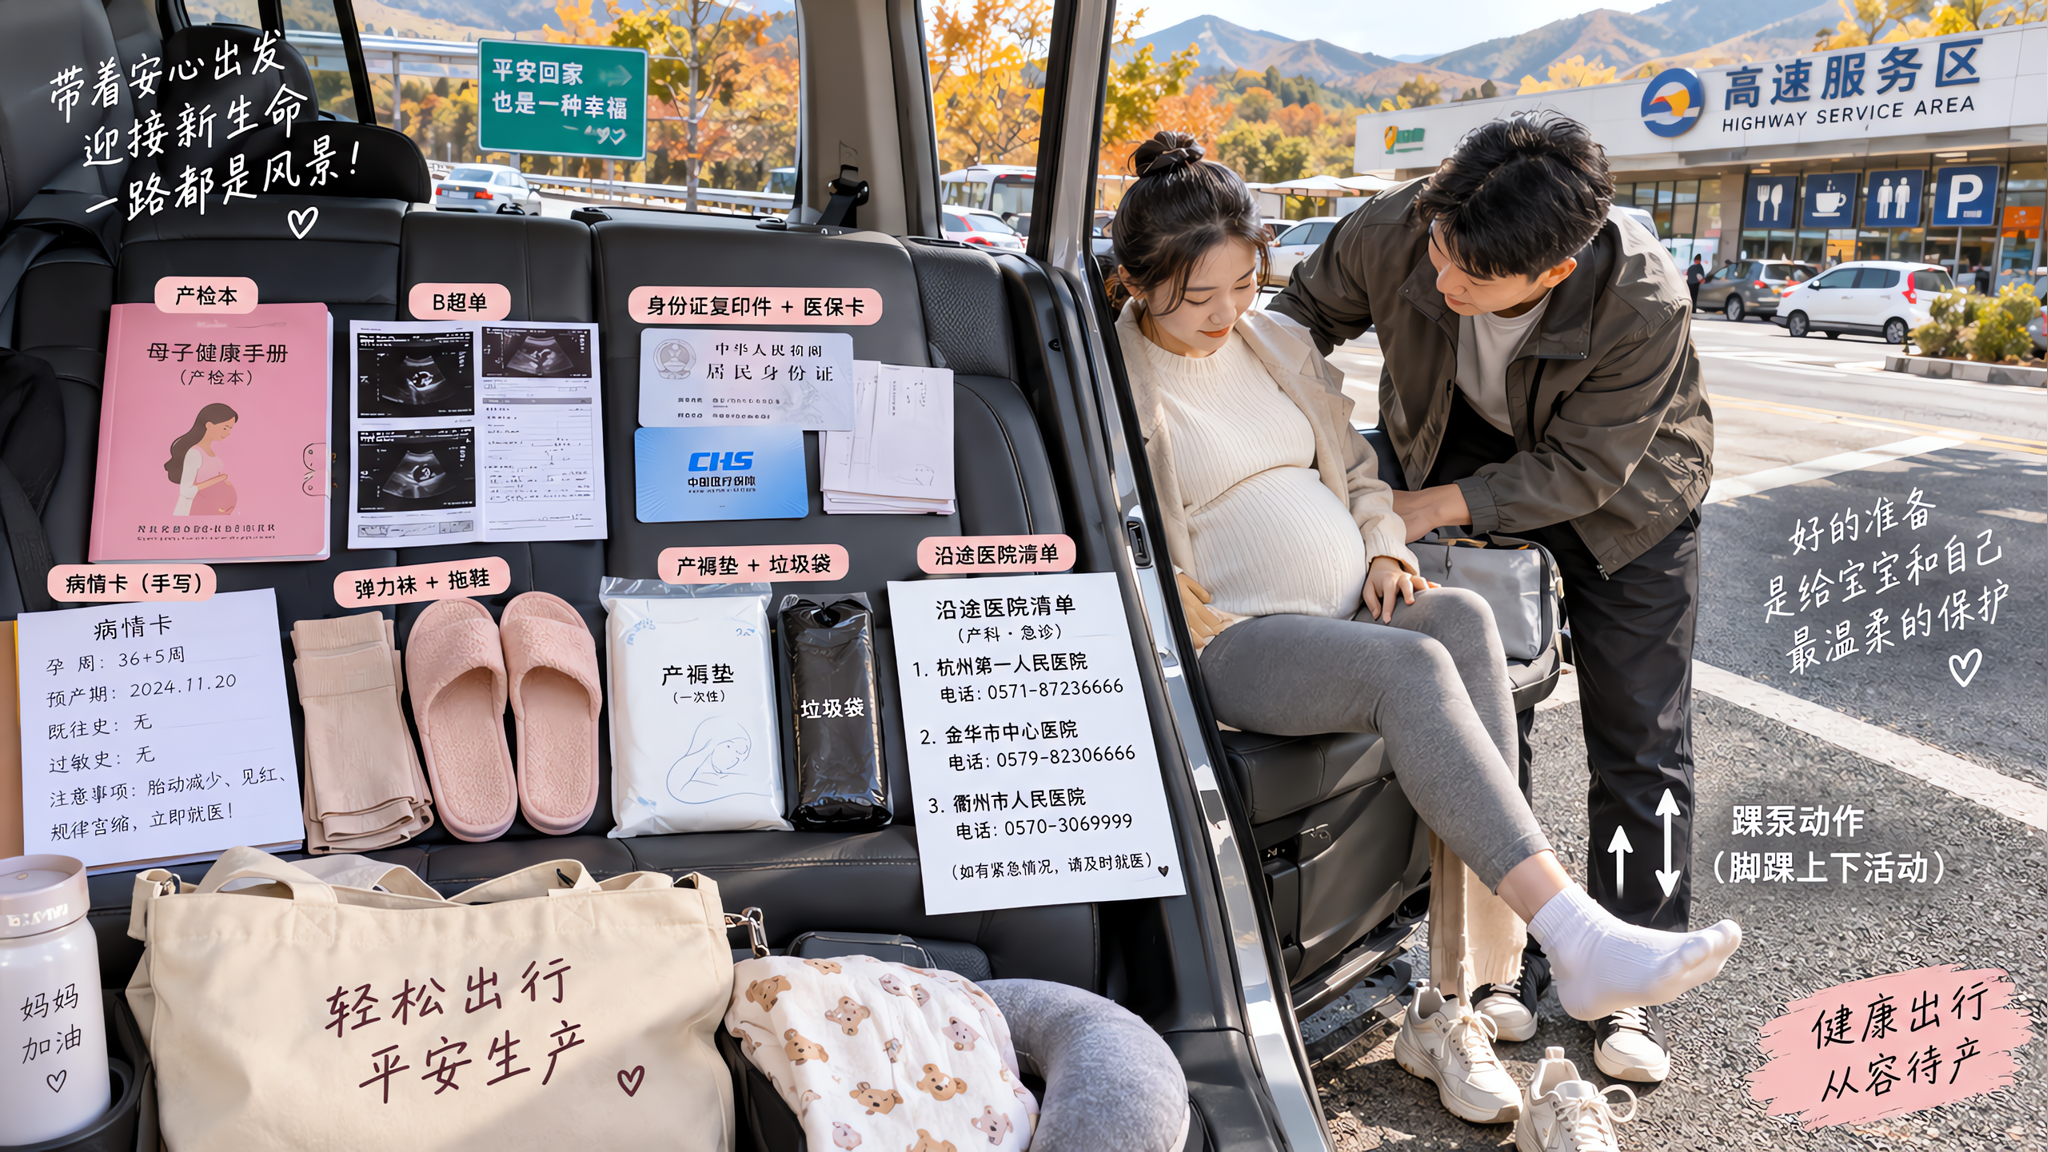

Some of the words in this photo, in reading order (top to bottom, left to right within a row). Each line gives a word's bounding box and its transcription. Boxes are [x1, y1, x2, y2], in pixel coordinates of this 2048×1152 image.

[493, 59, 582, 85] 平安回家
[1724, 38, 1983, 110] 高速服务区
[493, 91, 626, 119] 也是一种幸福
[1722, 111, 1807, 132] HIGHWAY
[1816, 102, 1904, 124] SERVICE
[1914, 96, 1974, 116] AREA
[1948, 175, 1982, 218] P
[147, 343, 288, 362] 母子健康手册
[180, 369, 252, 386] （产检本）
[707, 364, 832, 381] 居民身份证
[688, 451, 754, 472] CHS
[936, 595, 1075, 619] 沿途医院清单
[94, 614, 172, 640] 病情卡
[662, 663, 734, 685] 产褥垫
[913, 662, 927, 676] 1.
[937, 652, 1088, 676] 杭州第一人民医院
[131, 674, 236, 697] 2024.11.20
[988, 679, 1123, 699] 0571-87236666
[801, 698, 864, 718] 垃圾袋
[135, 714, 152, 729] 无
[921, 730, 935, 744] 2.
[946, 720, 1078, 744] 金华市中心医院
[137, 747, 154, 763] 无
[997, 745, 1135, 767] 0579-82306666
[929, 798, 944, 813] 3.
[953, 787, 1086, 813] 衢州市人民医院
[1005, 814, 1132, 835] 0570-3069999
[21, 984, 78, 1021] 妈妈
[323, 957, 573, 1040] 轻松出行
[23, 1024, 81, 1064] 加油
[358, 1020, 586, 1105] 平安生产
